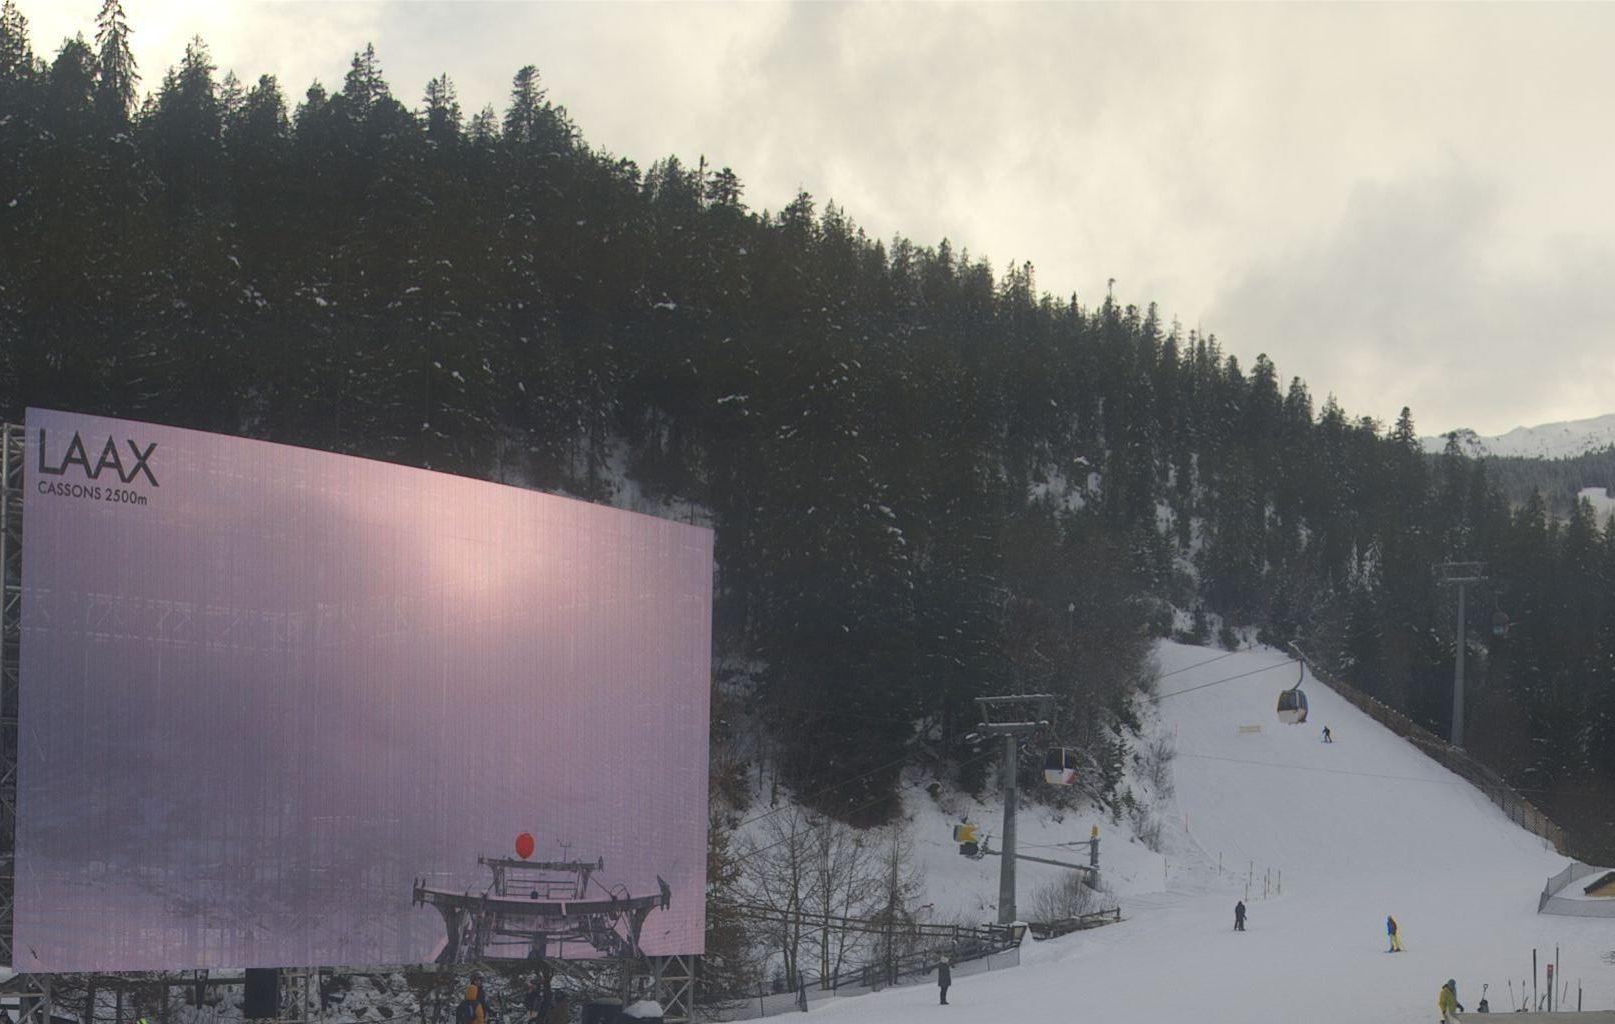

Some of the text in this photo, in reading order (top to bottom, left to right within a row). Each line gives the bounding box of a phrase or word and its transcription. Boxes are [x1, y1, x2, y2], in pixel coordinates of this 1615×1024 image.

[38, 428, 160, 487] LAAX
[37, 480, 148, 505] CASSONS 2500m
